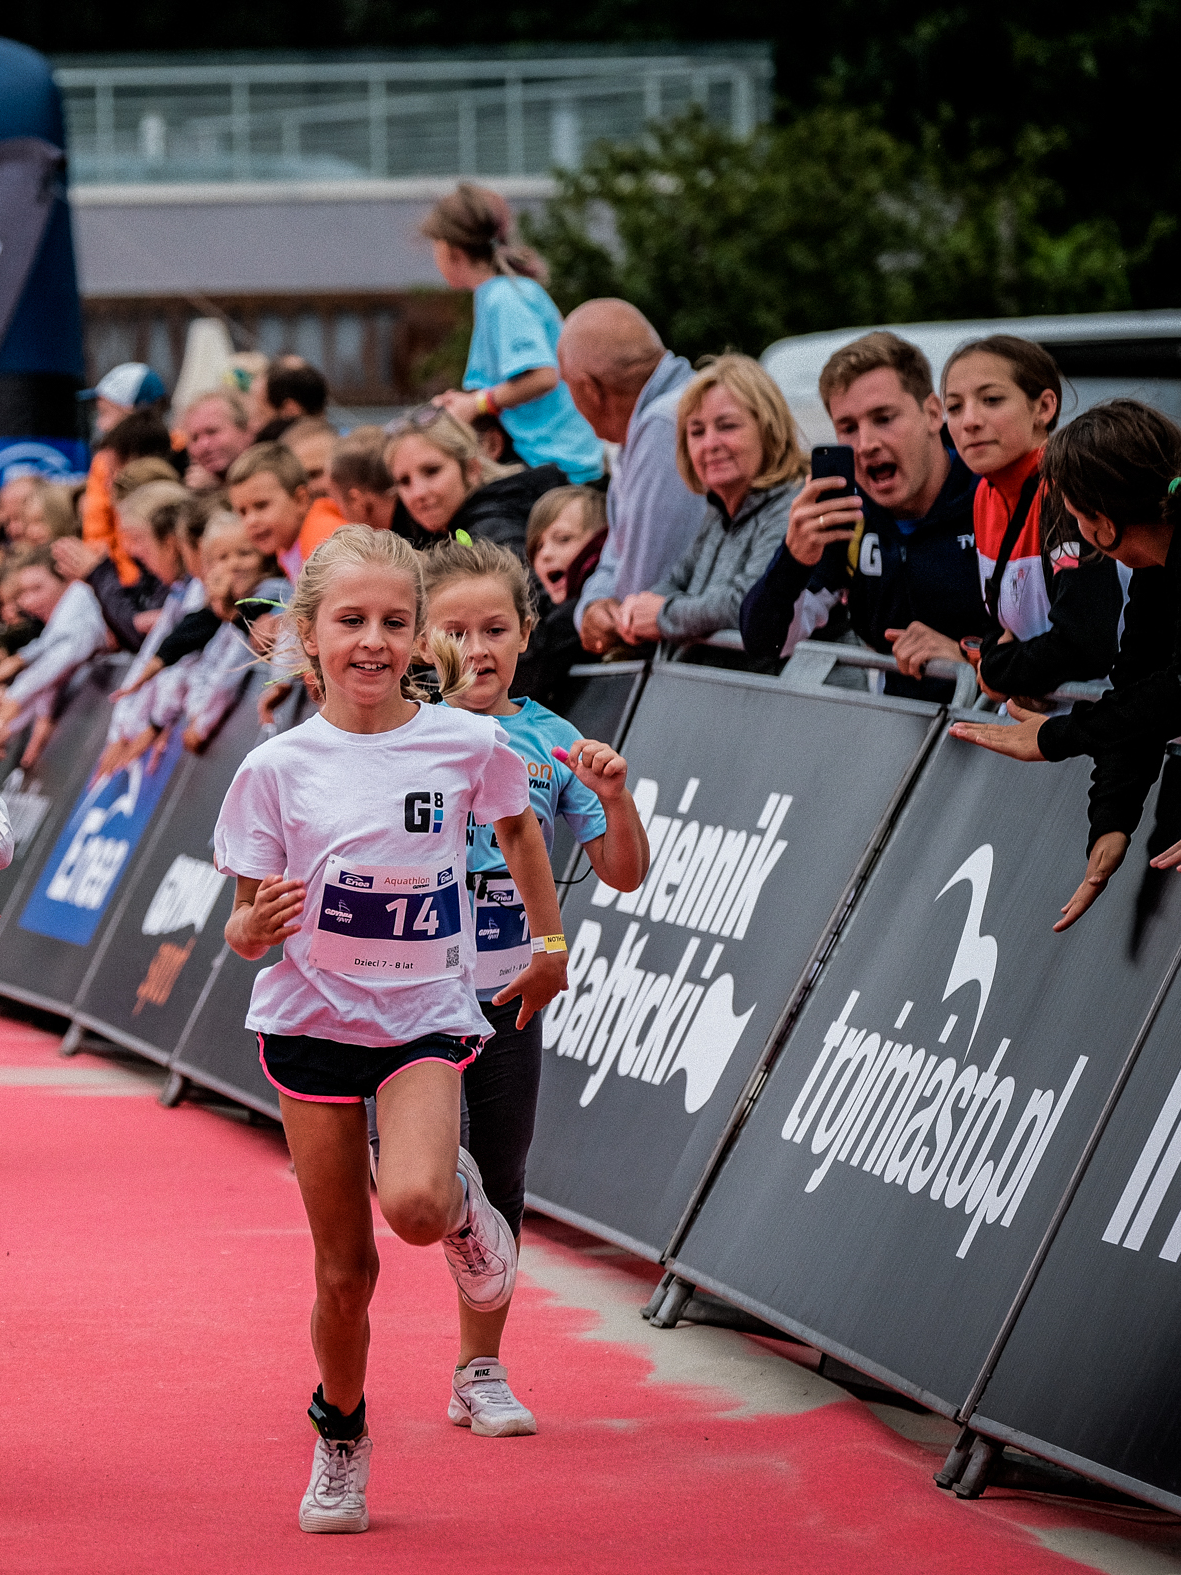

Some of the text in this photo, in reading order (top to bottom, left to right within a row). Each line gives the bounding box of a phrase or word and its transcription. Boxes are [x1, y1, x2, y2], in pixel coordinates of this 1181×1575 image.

[529, 778, 551, 790] YNIA
[46, 806, 130, 911] Enea
[345, 878, 370, 888] Enea
[384, 877, 430, 887] Aquathlon
[385, 896, 440, 936] 14
[354, 958, 380, 968] Dzieci
[381, 960, 387, 968] 7
[395, 961, 401, 969] 8
[402, 961, 414, 969] lat
[541, 918, 725, 1108] Bałtycki
[781, 989, 1089, 1259] trojmiasto.pl
[474, 1368, 490, 1378] NIKE
